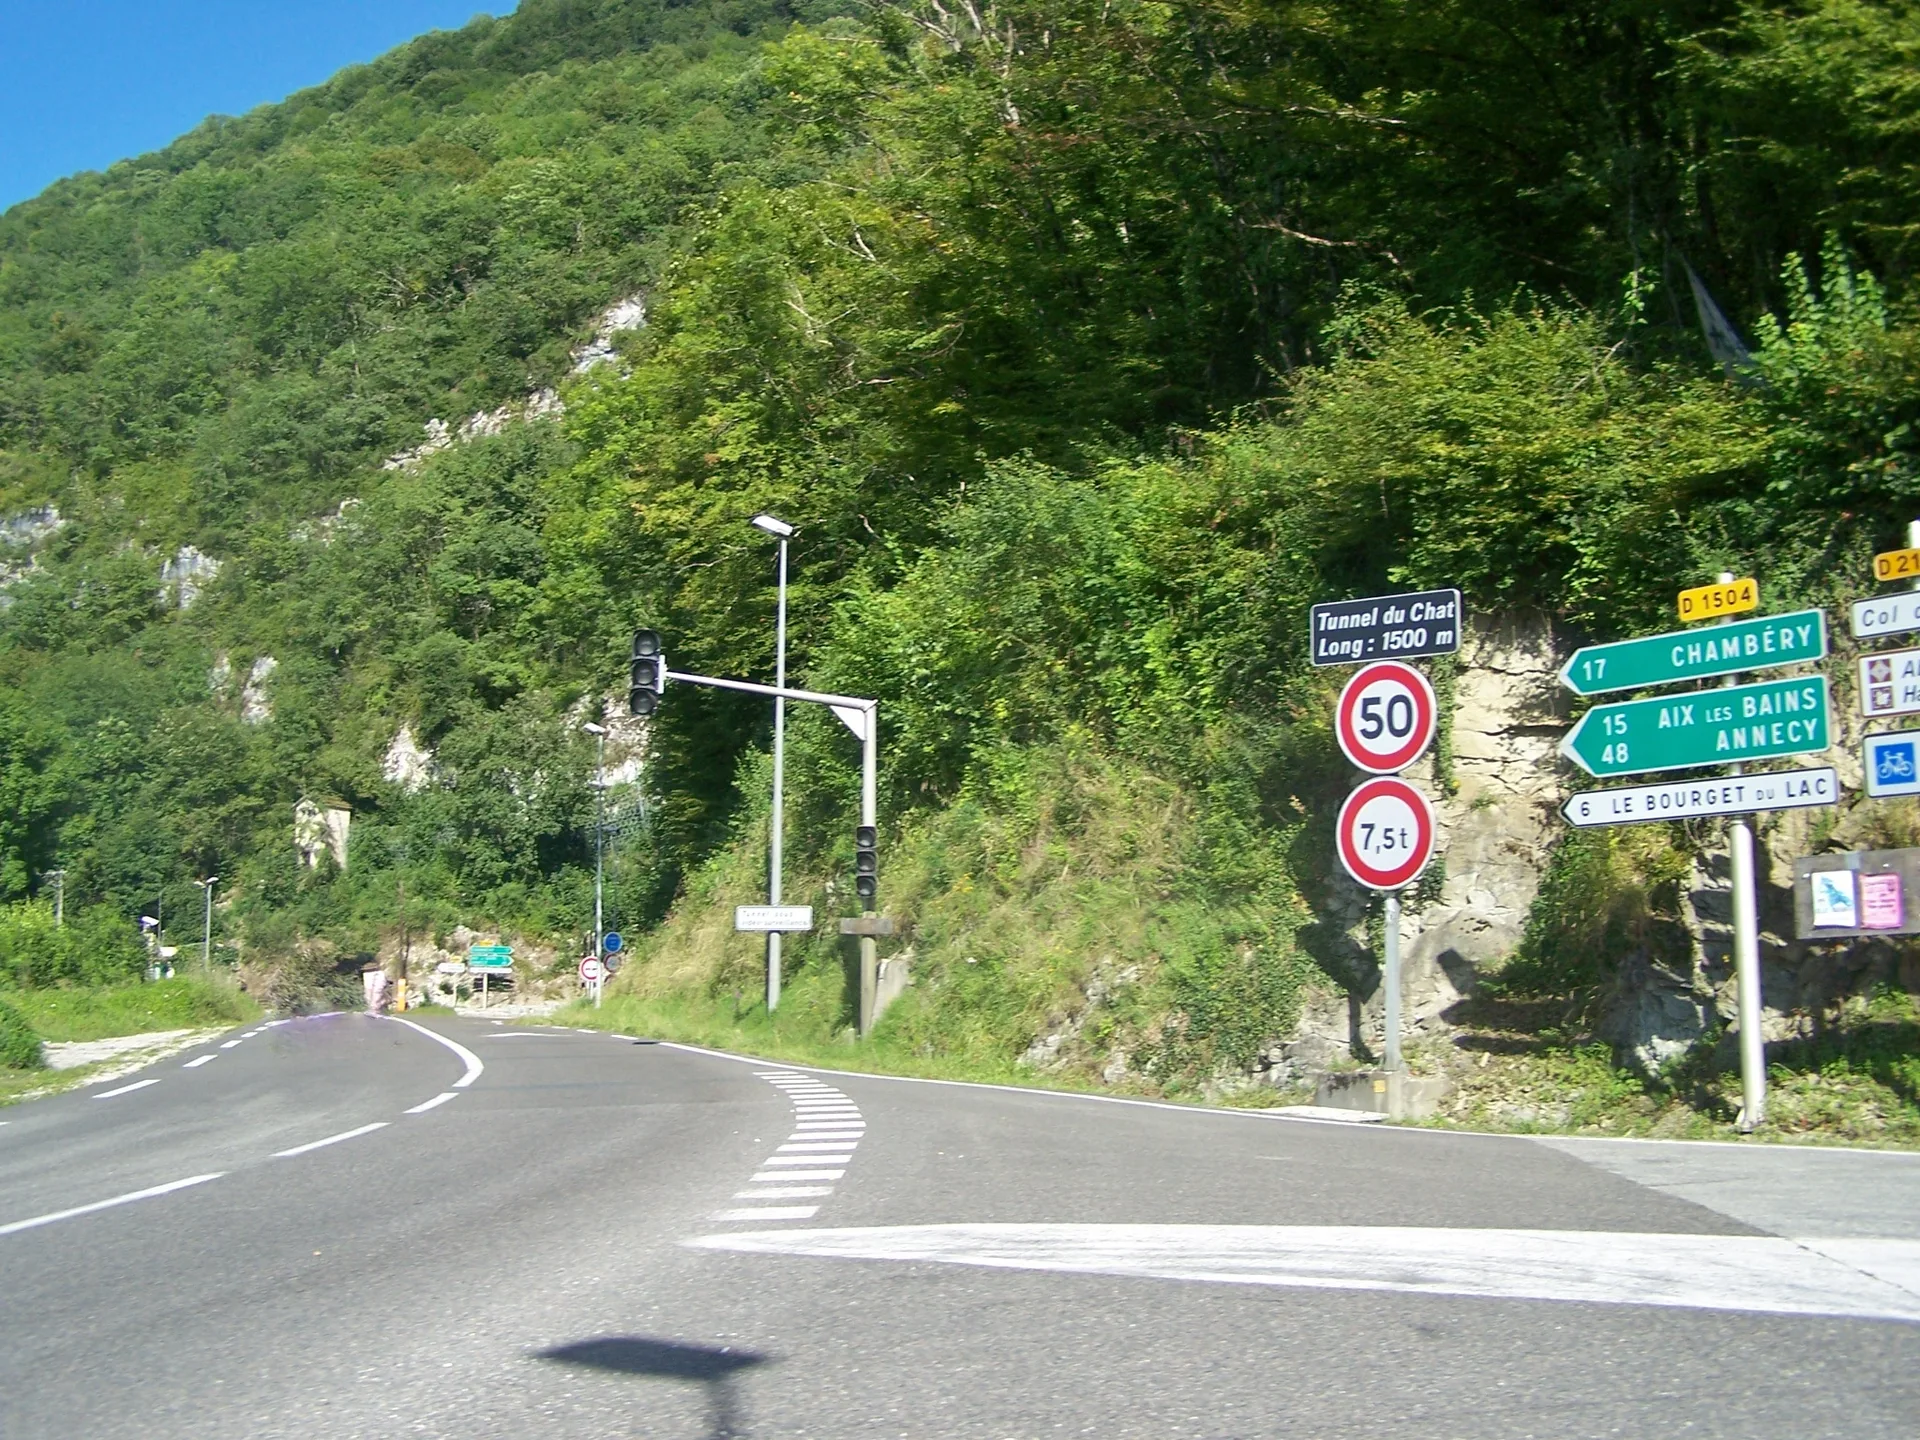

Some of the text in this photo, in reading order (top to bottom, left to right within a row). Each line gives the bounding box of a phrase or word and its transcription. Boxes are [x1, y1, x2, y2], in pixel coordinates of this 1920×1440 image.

[1878, 558, 1890, 576] D
[1317, 601, 1455, 631] Tunnel du Chat
[1682, 586, 1751, 614] D 1504
[1862, 604, 1898, 627] Col
[1382, 628, 1427, 651] 1500
[1435, 630, 1453, 645] m
[1582, 624, 1812, 681] 17 CHAMBÉRY
[1359, 693, 1414, 740] 50
[1602, 687, 1817, 736] 15 AIX LES BAINS
[1601, 718, 1818, 764] 48 ANNECY
[1580, 801, 1590, 817] 6
[1612, 797, 1633, 814] LE
[1646, 785, 1745, 811] BOURGET
[1786, 778, 1827, 798] LAC
